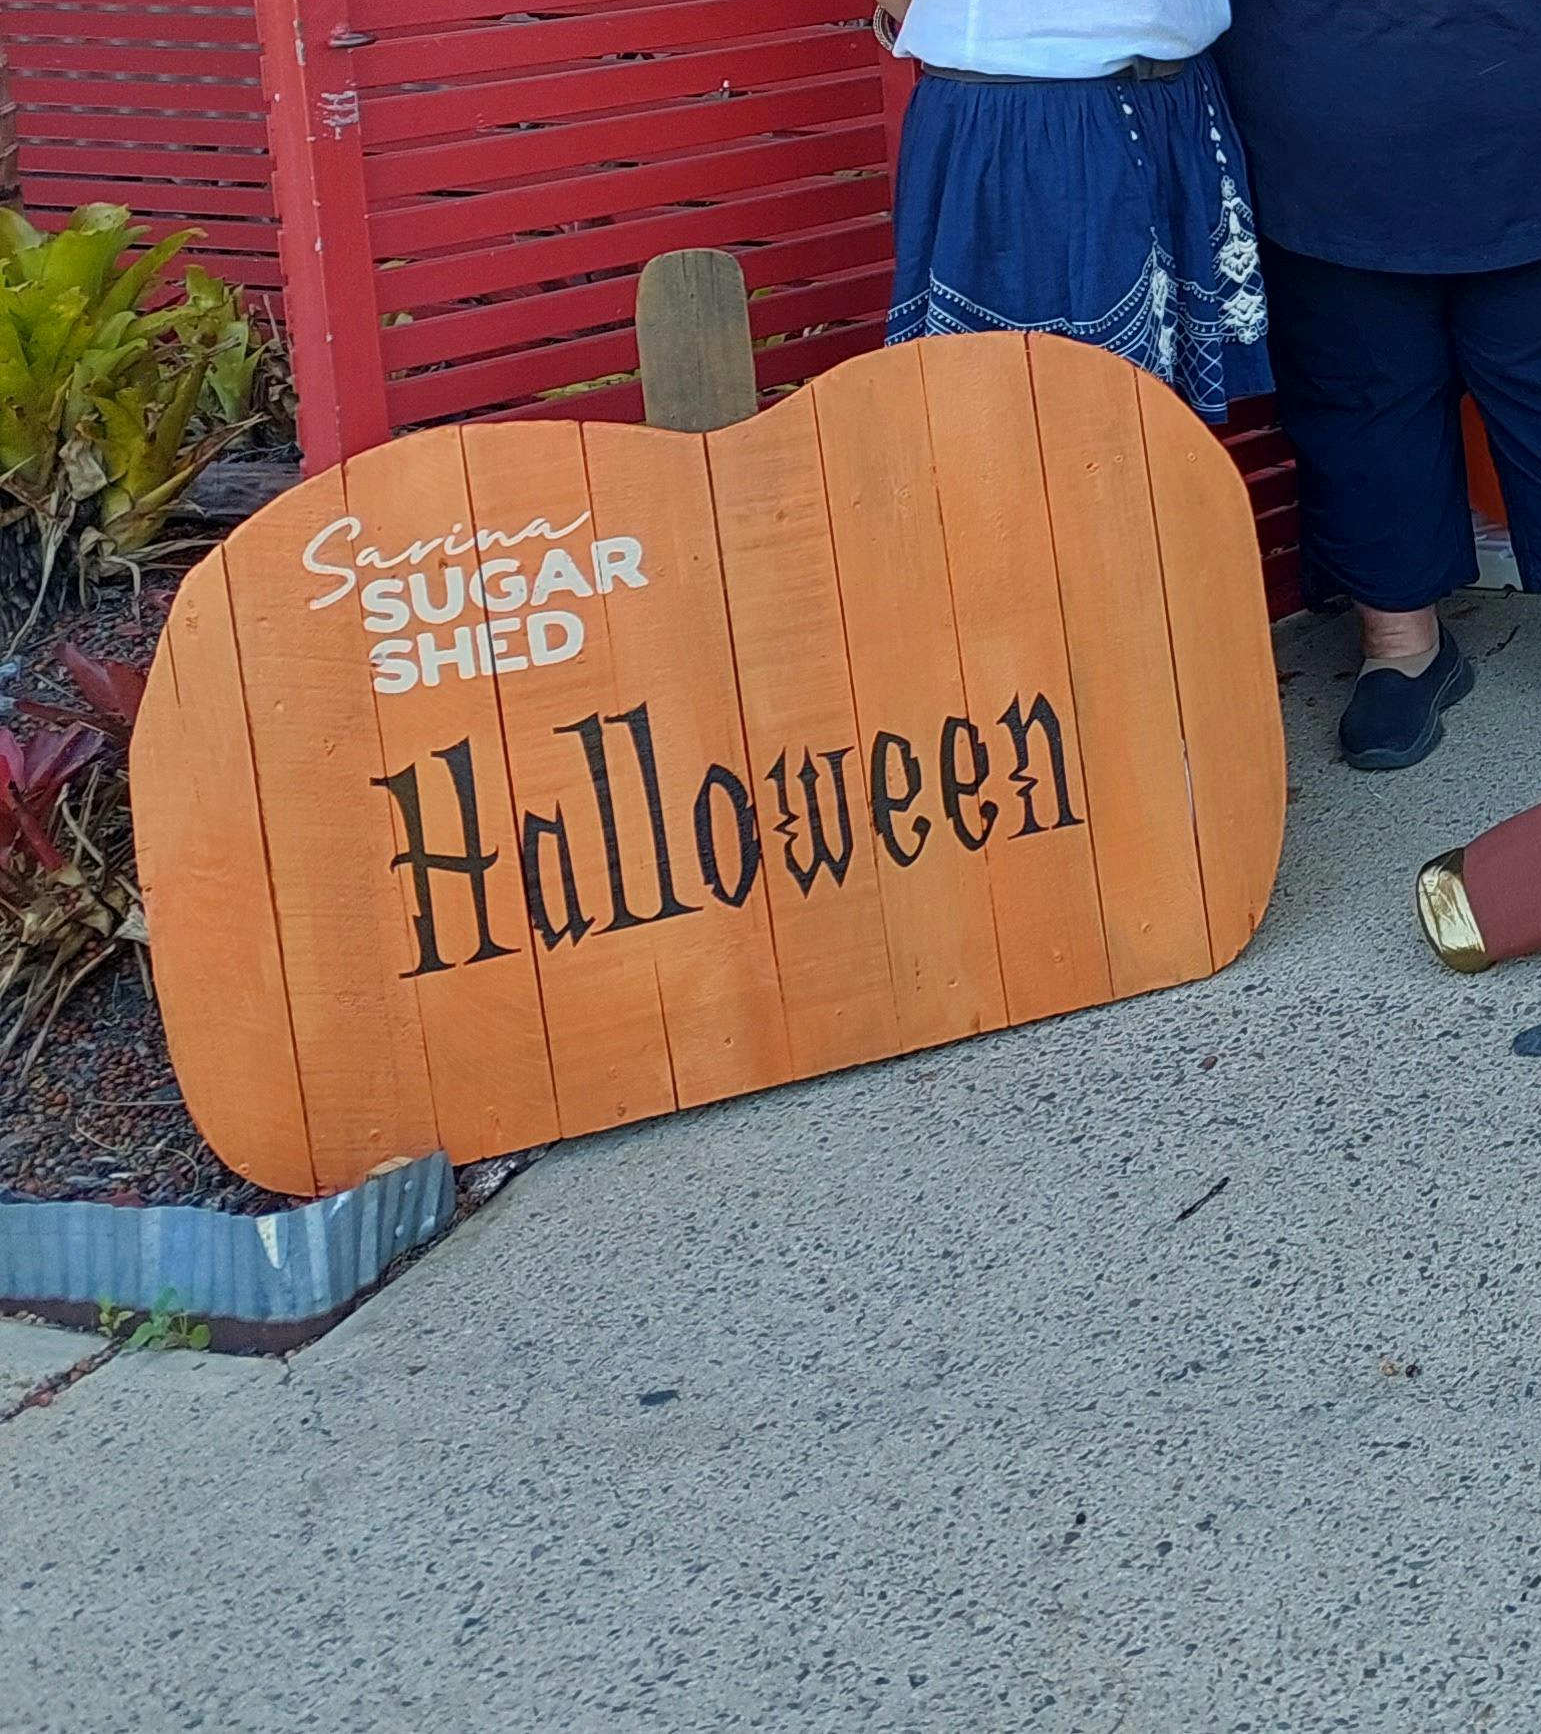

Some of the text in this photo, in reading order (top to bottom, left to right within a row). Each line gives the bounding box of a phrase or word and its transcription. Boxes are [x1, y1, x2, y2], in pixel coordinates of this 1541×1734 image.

[302, 510, 591, 610] Sarina
[360, 535, 649, 634] SUGAR
[368, 610, 585, 695] SHED
[369, 690, 1086, 980] Halloween
